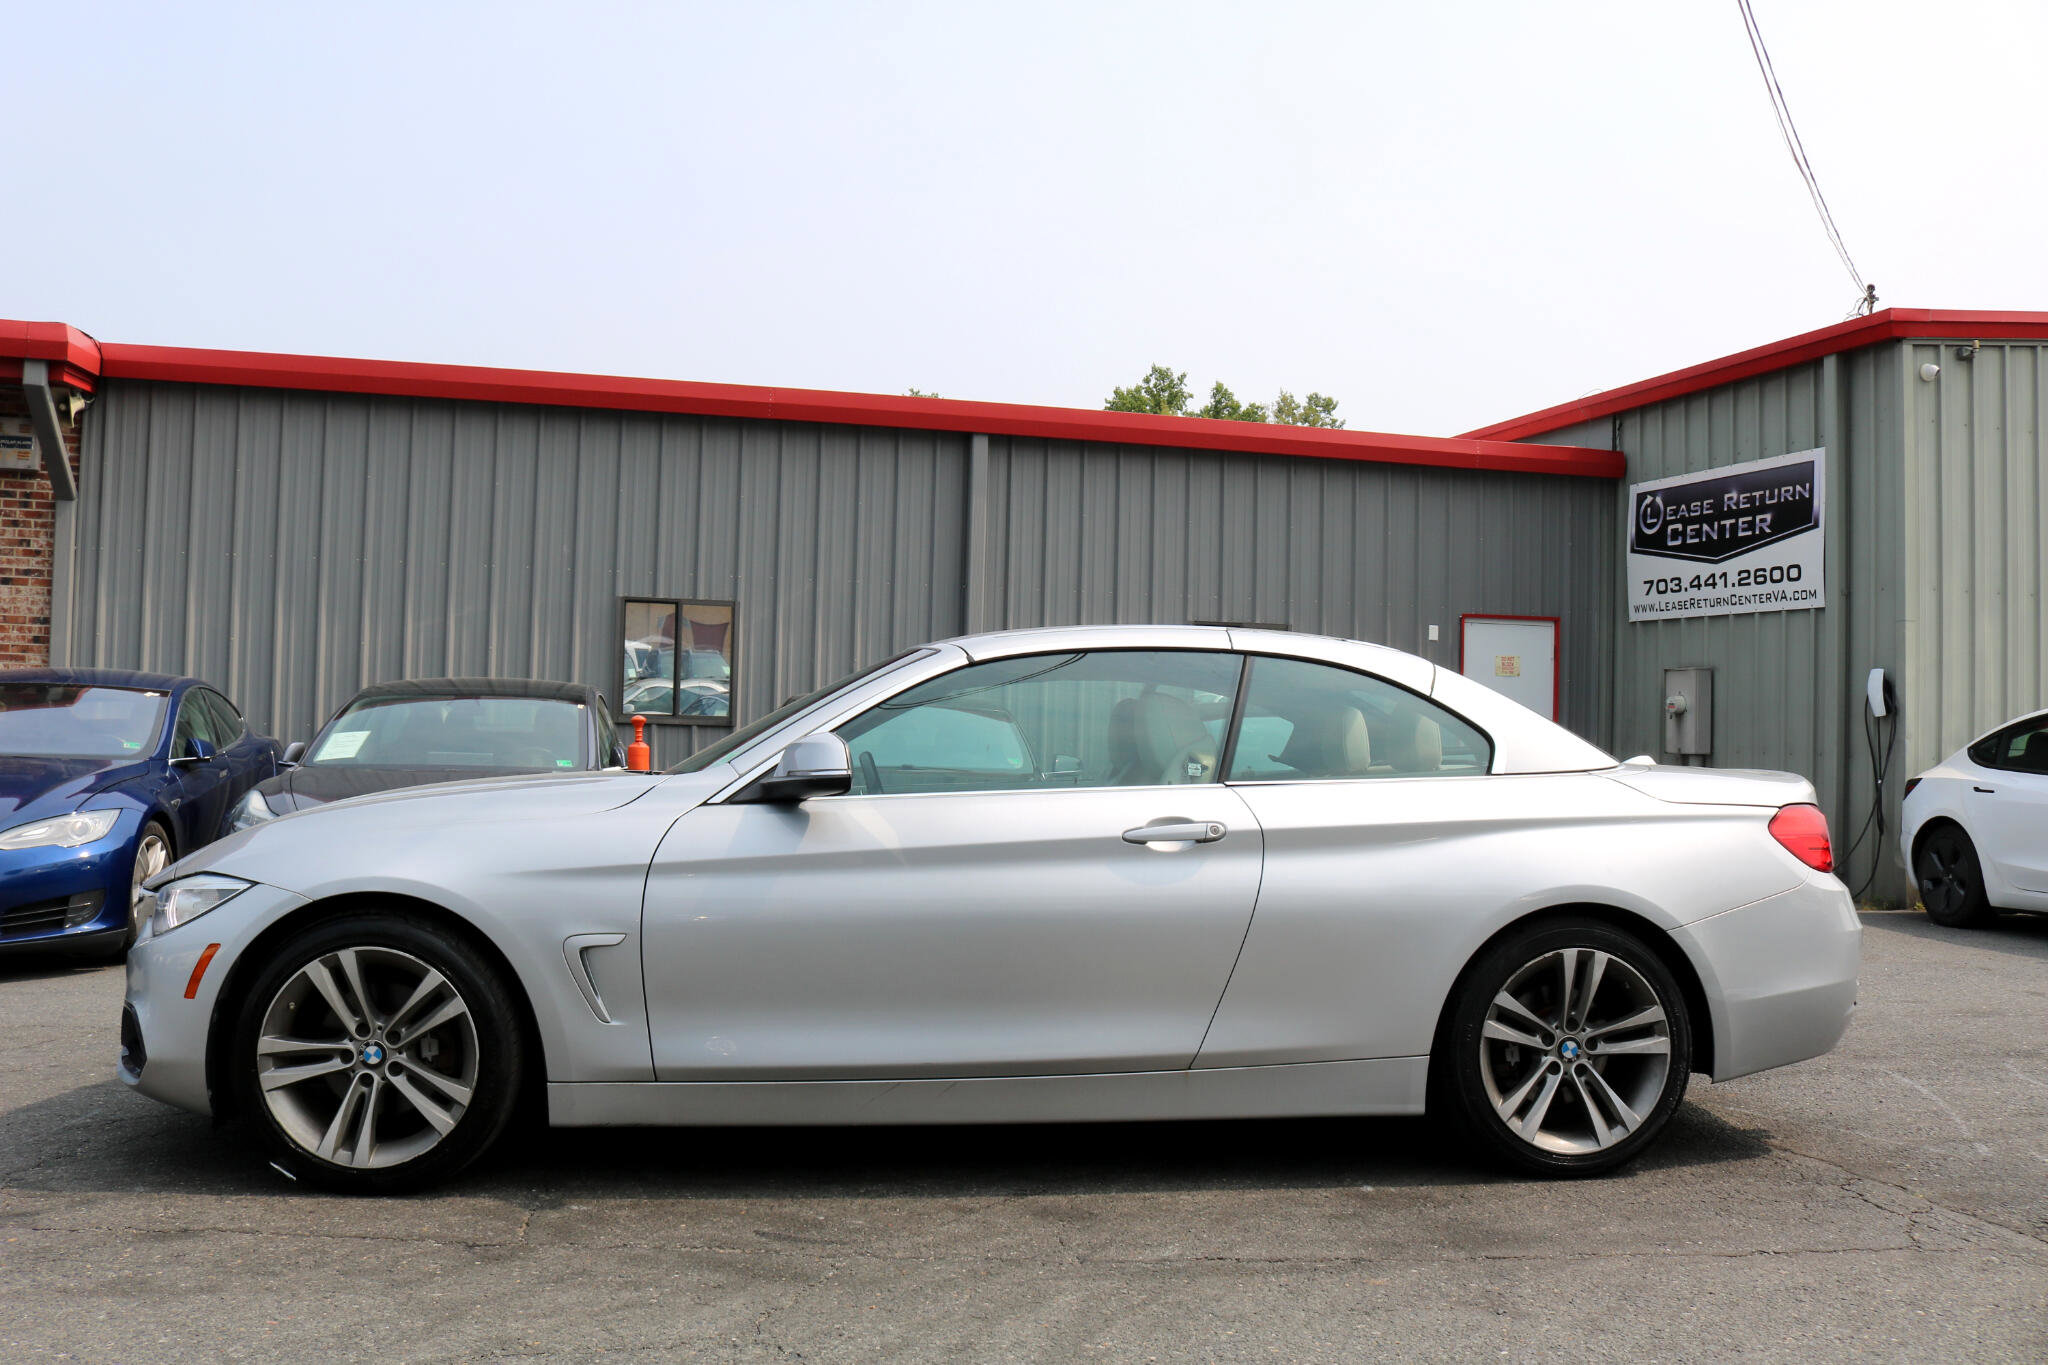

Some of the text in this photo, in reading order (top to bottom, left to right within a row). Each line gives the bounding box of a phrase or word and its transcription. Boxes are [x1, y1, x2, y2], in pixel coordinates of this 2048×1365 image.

[1723, 482, 1810, 512] RETURN
[1666, 512, 1773, 546] CENTER
[1643, 563, 1802, 596] 703.441.2600
